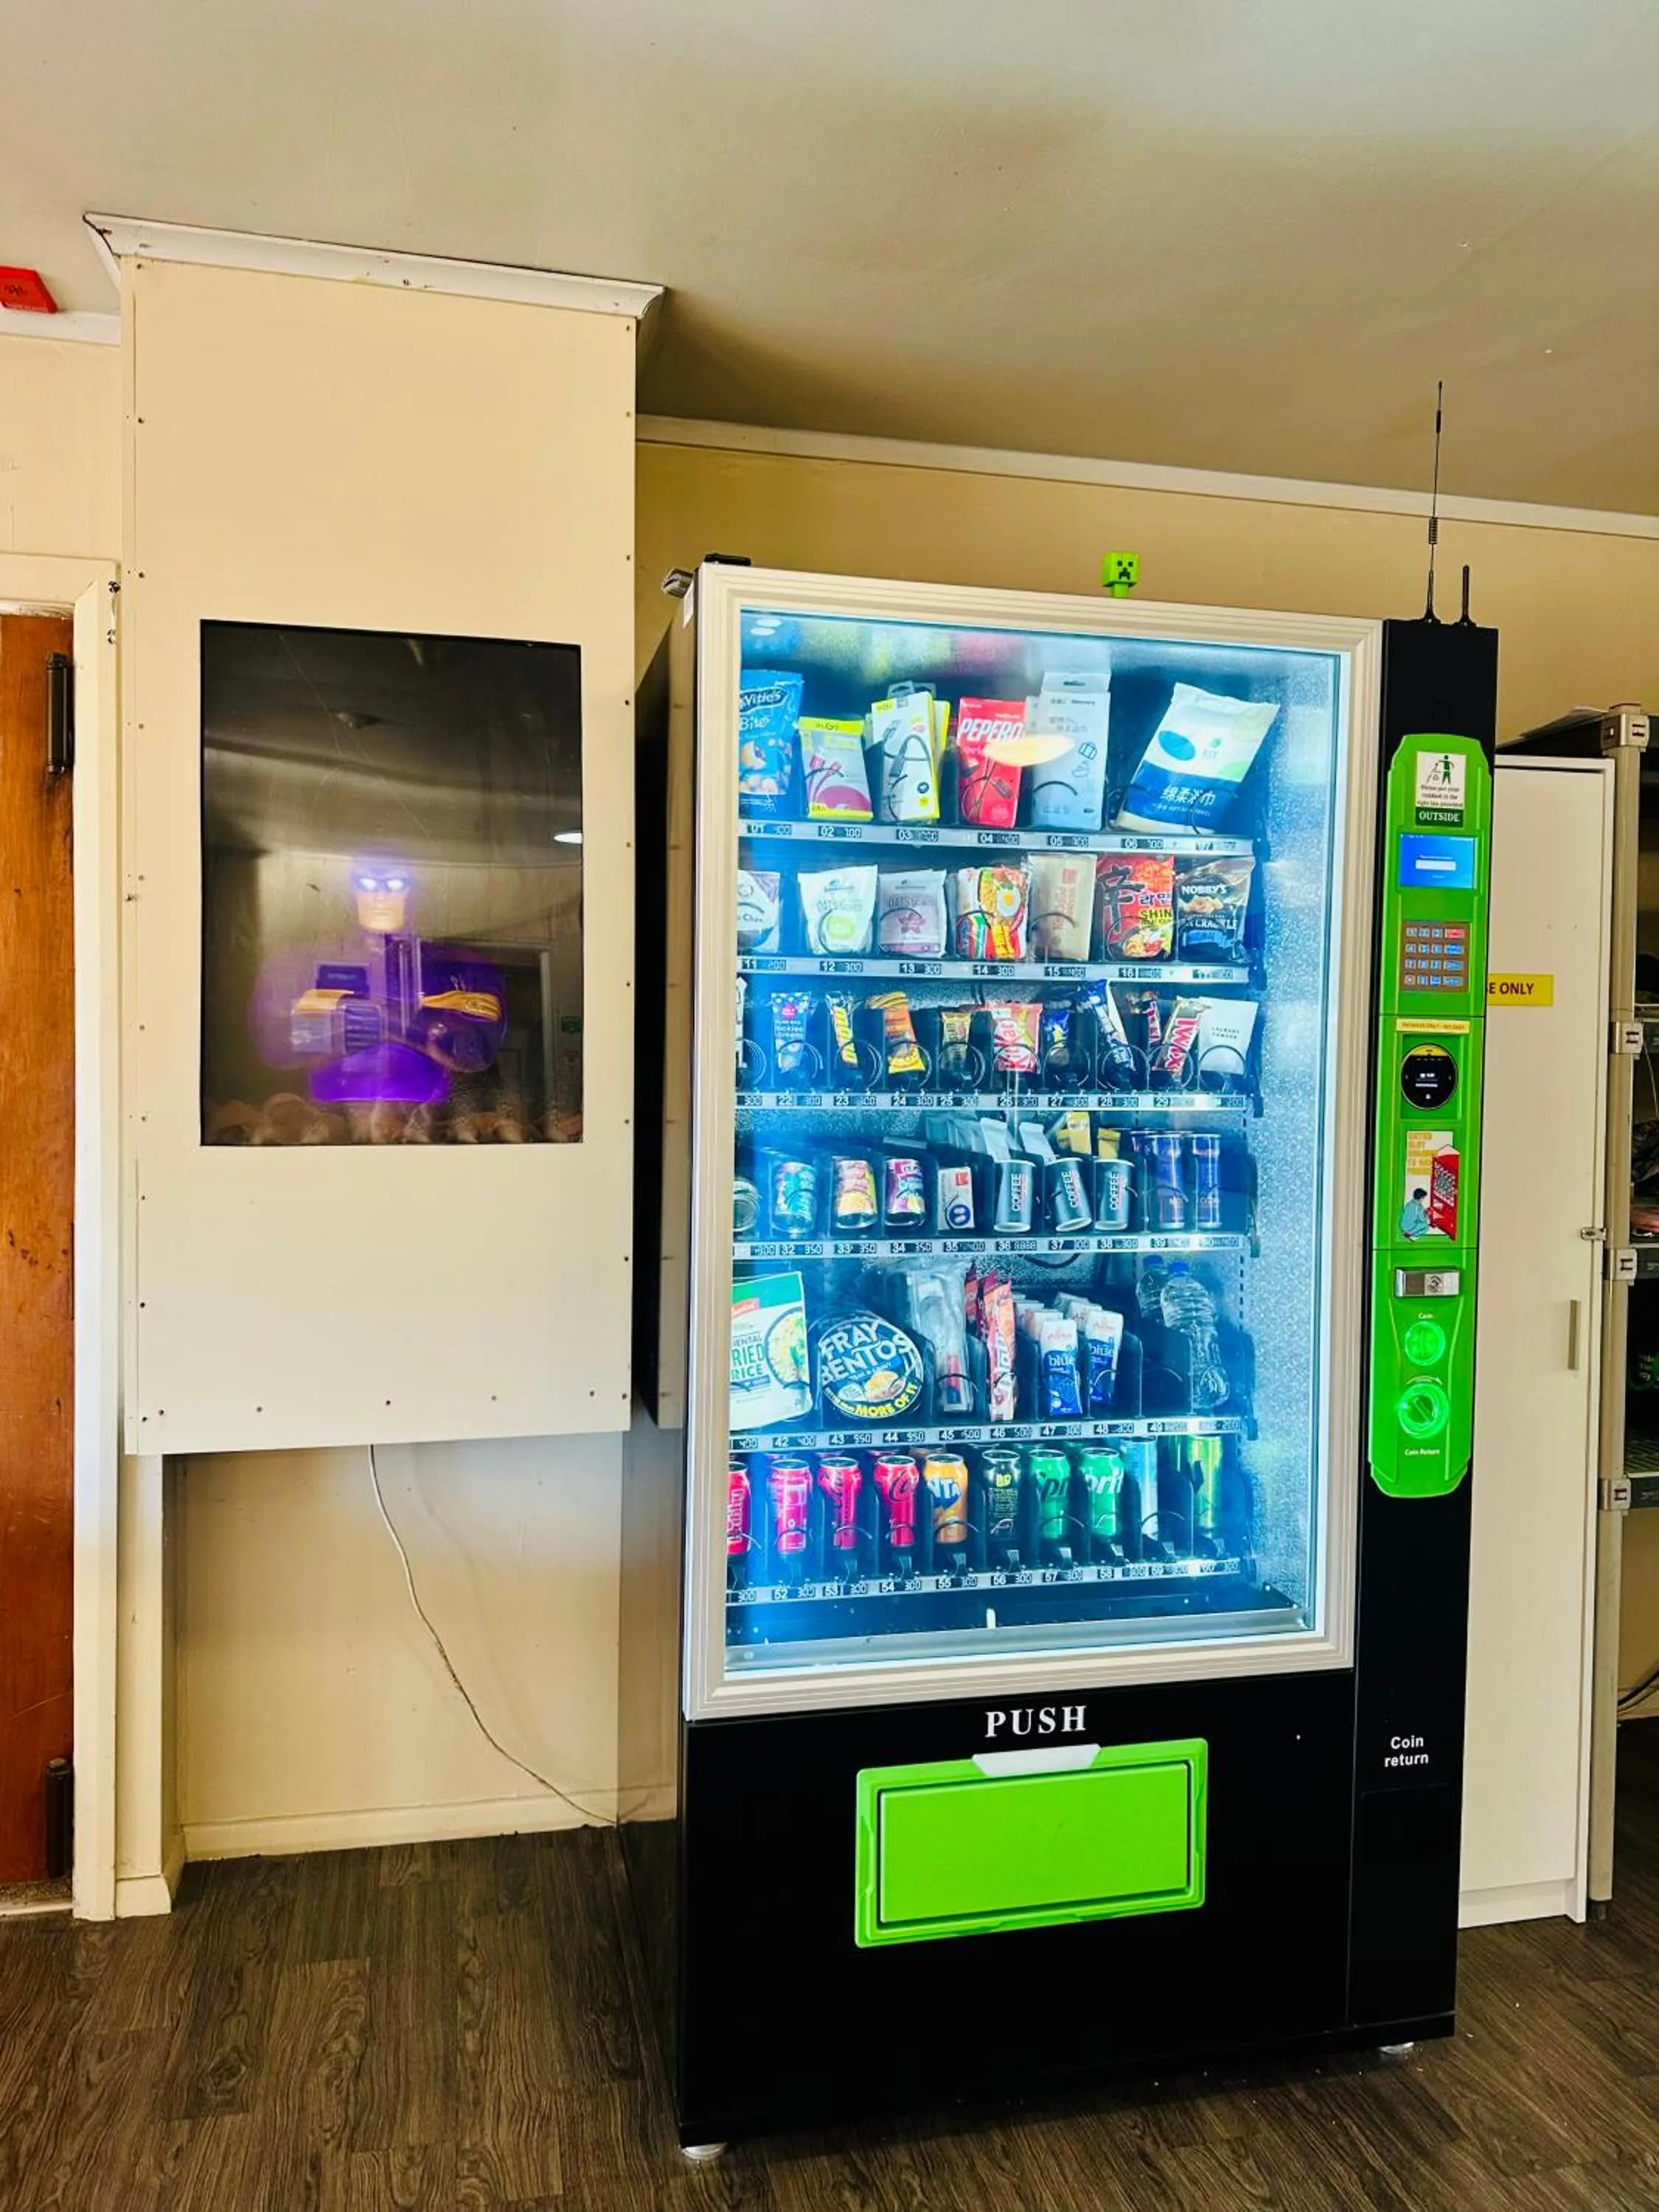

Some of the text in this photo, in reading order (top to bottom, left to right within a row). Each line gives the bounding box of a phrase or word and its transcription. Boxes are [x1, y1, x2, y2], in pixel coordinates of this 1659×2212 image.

[960, 717, 1024, 742] PEPERO
[1418, 810, 1461, 823] OUTSIDE
[821, 827, 834, 837] 02
[898, 830, 911, 840] 03
[980, 834, 992, 844] 04
[1049, 837, 1062, 846] 05
[1180, 883, 1228, 895] NOBBY'S
[1140, 908, 1172, 919] SHIN
[745, 961, 757, 970] 11
[823, 962, 835, 972] 12
[902, 964, 915, 973] 13
[975, 966, 988, 975] 14
[1047, 967, 1060, 976] 15
[1121, 969, 1134, 978] 16
[1487, 981, 1534, 995] E ONLY
[779, 1096, 791, 1105] 22
[836, 1096, 849, 1105] 23
[893, 1096, 906, 1106] 24
[940, 1096, 953, 1106] 25
[1000, 1096, 1013, 1106] 26
[1051, 1097, 1064, 1106] 27
[1101, 1097, 1113, 1106] 28
[1155, 1097, 1169, 1106] 29
[1011, 1173, 1021, 1211] COFFEE
[1062, 1170, 1079, 1208] COFFEE
[1110, 1172, 1120, 1211] COFFEE
[892, 1243, 905, 1253] 34
[1051, 1240, 1064, 1249] 37
[1101, 1239, 1113, 1248] 38
[781, 1245, 795, 1254] 32
[838, 1244, 851, 1253] 33
[820, 1319, 880, 1360] FRAY
[731, 1343, 765, 1367] RIED
[821, 1333, 911, 1385] BENTOS
[731, 1363, 764, 1380] RICE
[855, 1382, 918, 1416] MORE OF IT
[1043, 1426, 1056, 1436] 47
[1096, 1425, 1109, 1434] 48
[1151, 1423, 1163, 1432] 49
[885, 1433, 898, 1441] 44
[941, 1430, 955, 1439] 45
[992, 1429, 1006, 1438] 46
[775, 1438, 788, 1447] 42
[831, 1435, 844, 1444] 43
[1100, 1570, 1113, 1579] 58
[1152, 1566, 1164, 1575] 59
[993, 1576, 1006, 1585] 56
[1045, 1573, 1057, 1582] 57
[881, 1582, 894, 1592] 54
[939, 1579, 952, 1589] 55
[774, 1590, 788, 1599] 52
[825, 1587, 838, 1596] 53
[984, 1705, 1088, 1737] PUSH
[1390, 1733, 1424, 1751] Coin
[1384, 1750, 1429, 1768] return
